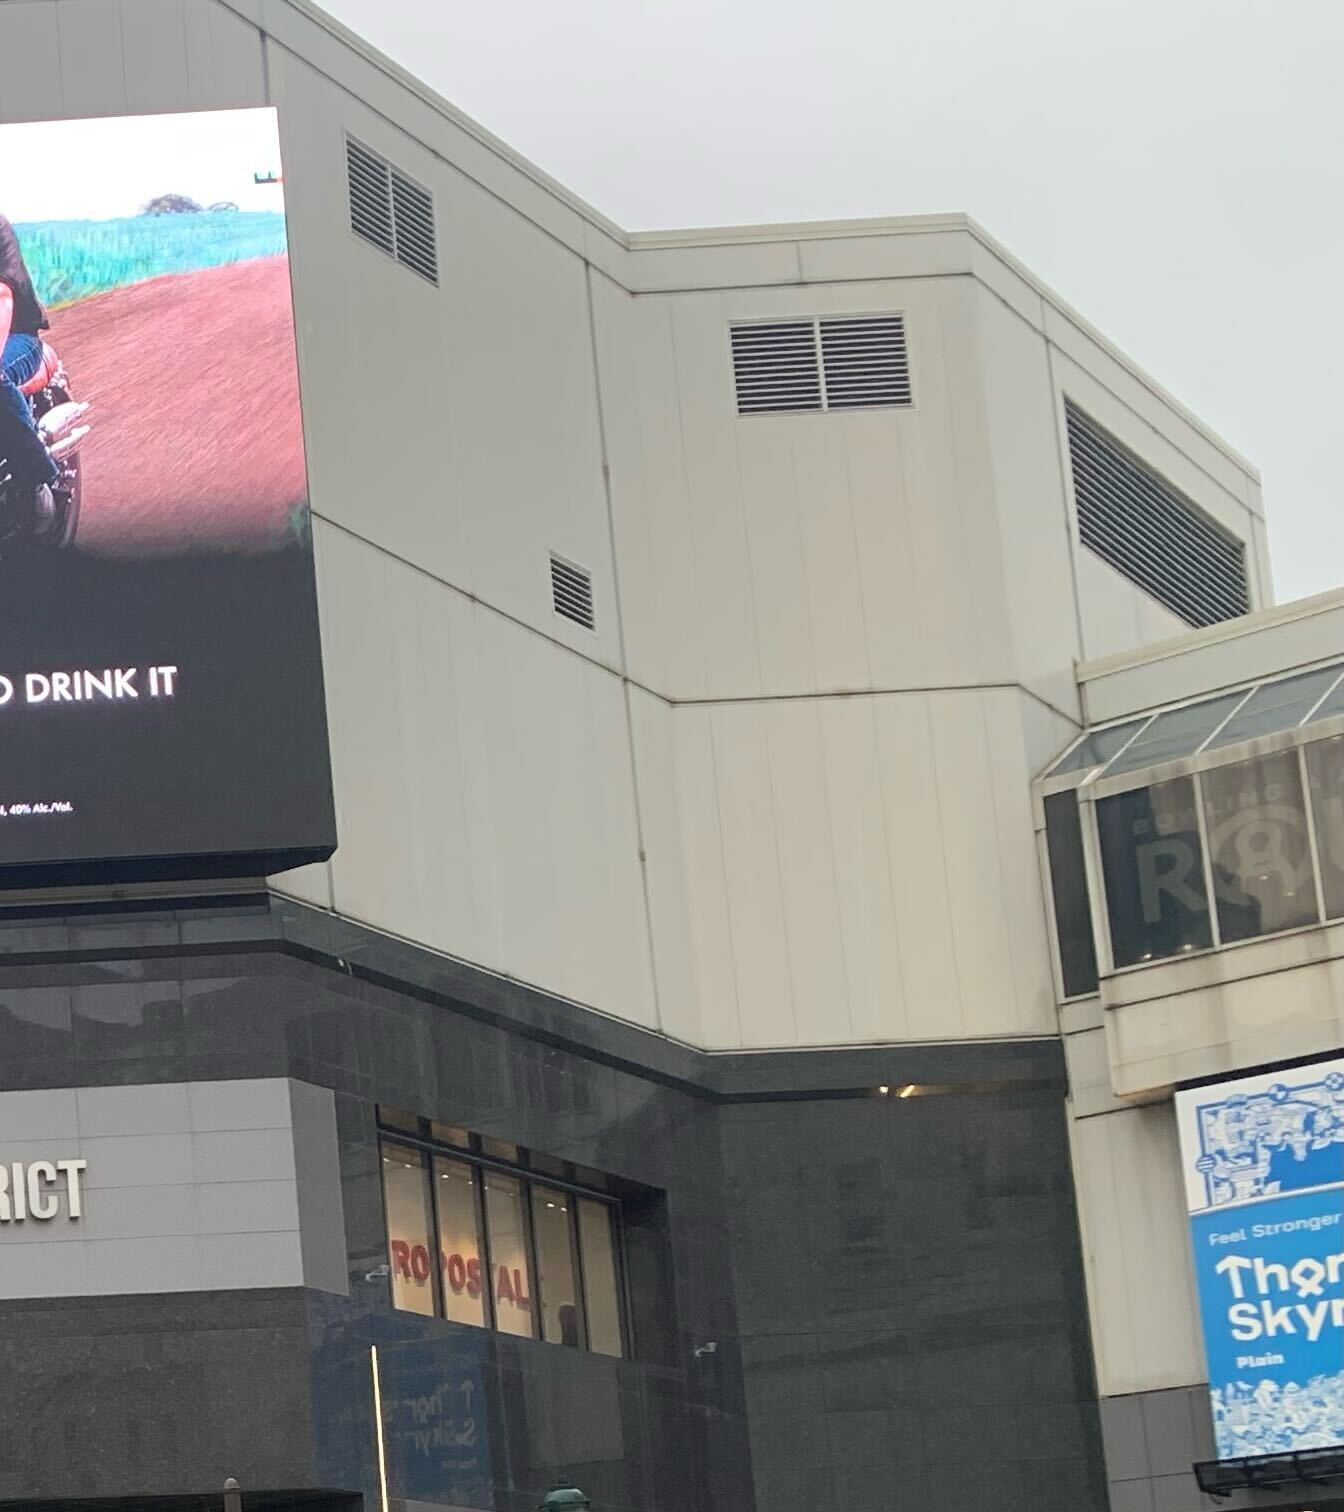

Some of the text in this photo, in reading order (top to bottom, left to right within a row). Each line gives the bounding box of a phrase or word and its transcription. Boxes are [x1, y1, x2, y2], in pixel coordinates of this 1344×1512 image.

[26, 668, 138, 703] DRINK
[149, 666, 178, 697] IT
[11, 803, 32, 815] 40%
[1209, 1213, 1342, 1246] Feel Stronger
[1236, 1352, 1286, 1369] Plain
